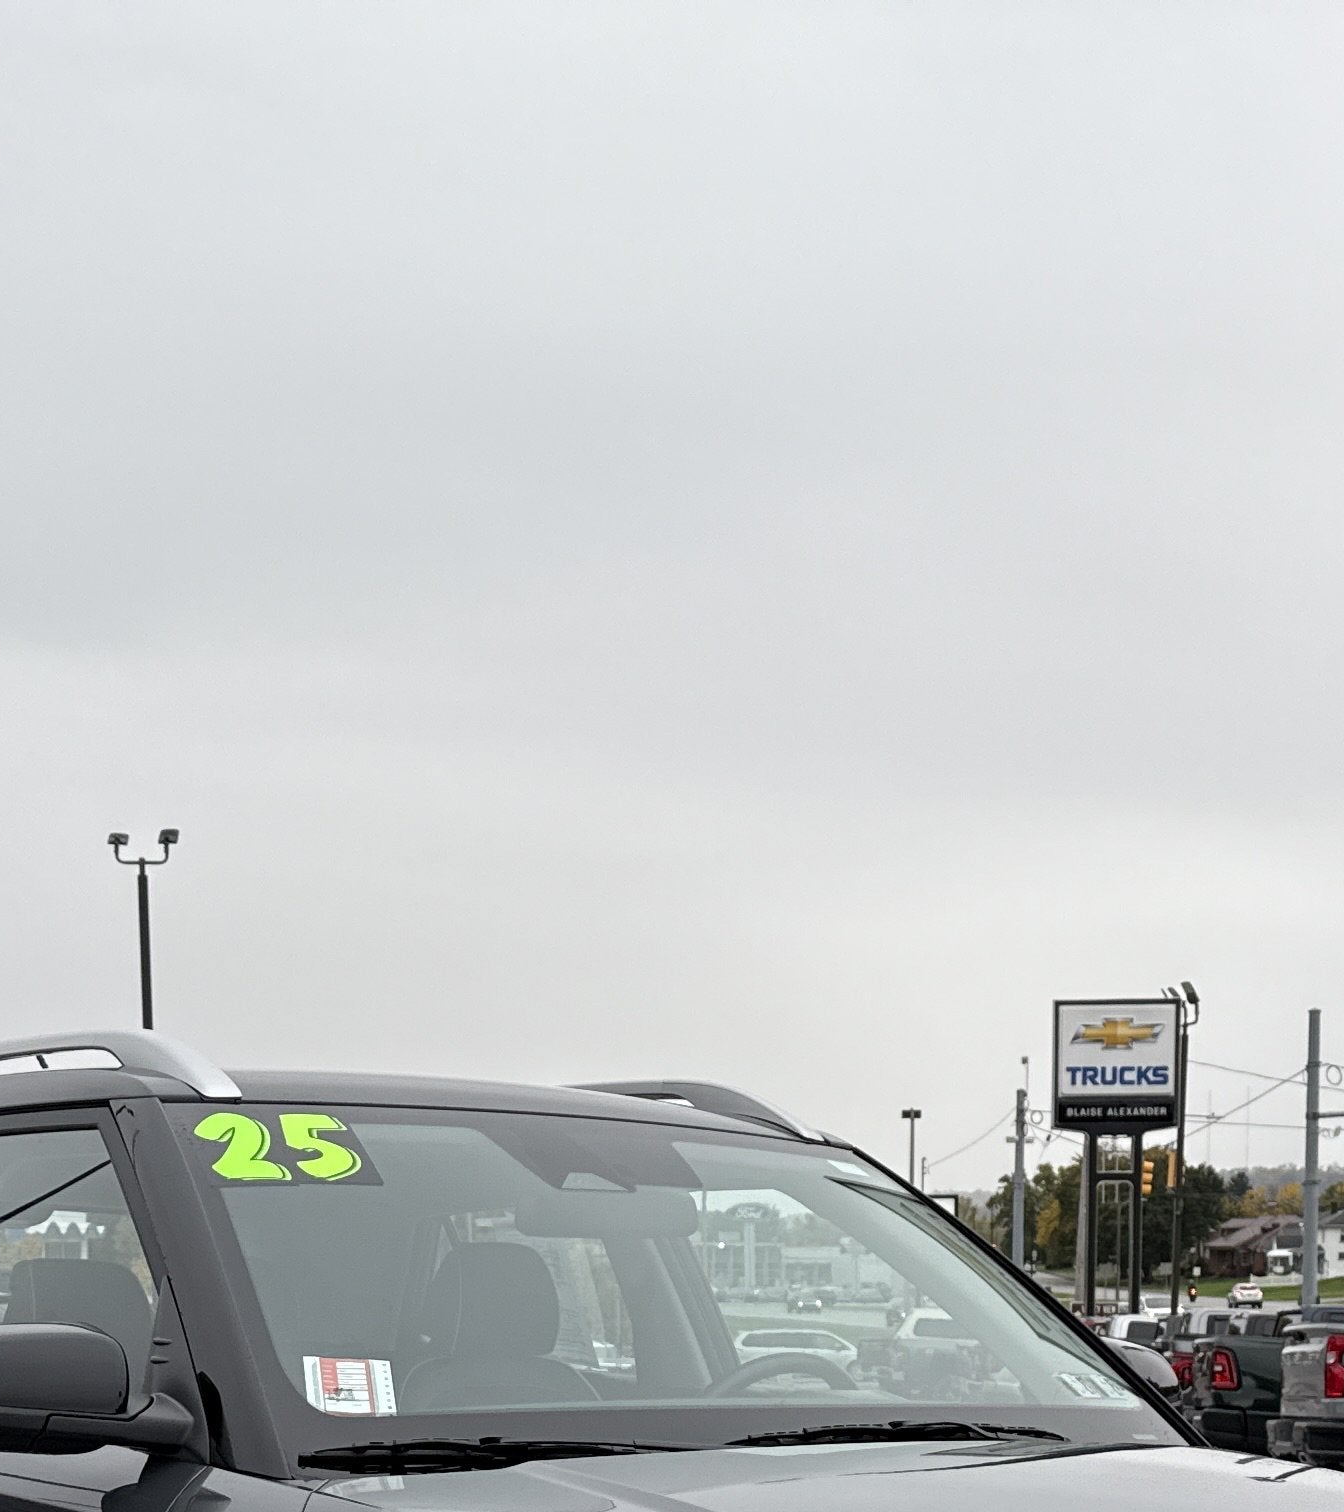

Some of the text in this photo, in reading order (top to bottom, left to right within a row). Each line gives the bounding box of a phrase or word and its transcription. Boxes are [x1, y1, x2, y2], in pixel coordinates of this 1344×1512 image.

[1066, 1065, 1169, 1085] TRUCKS
[1066, 1106, 1167, 1117] BLAISE ALEXANDER
[193, 1112, 362, 1181] 25
